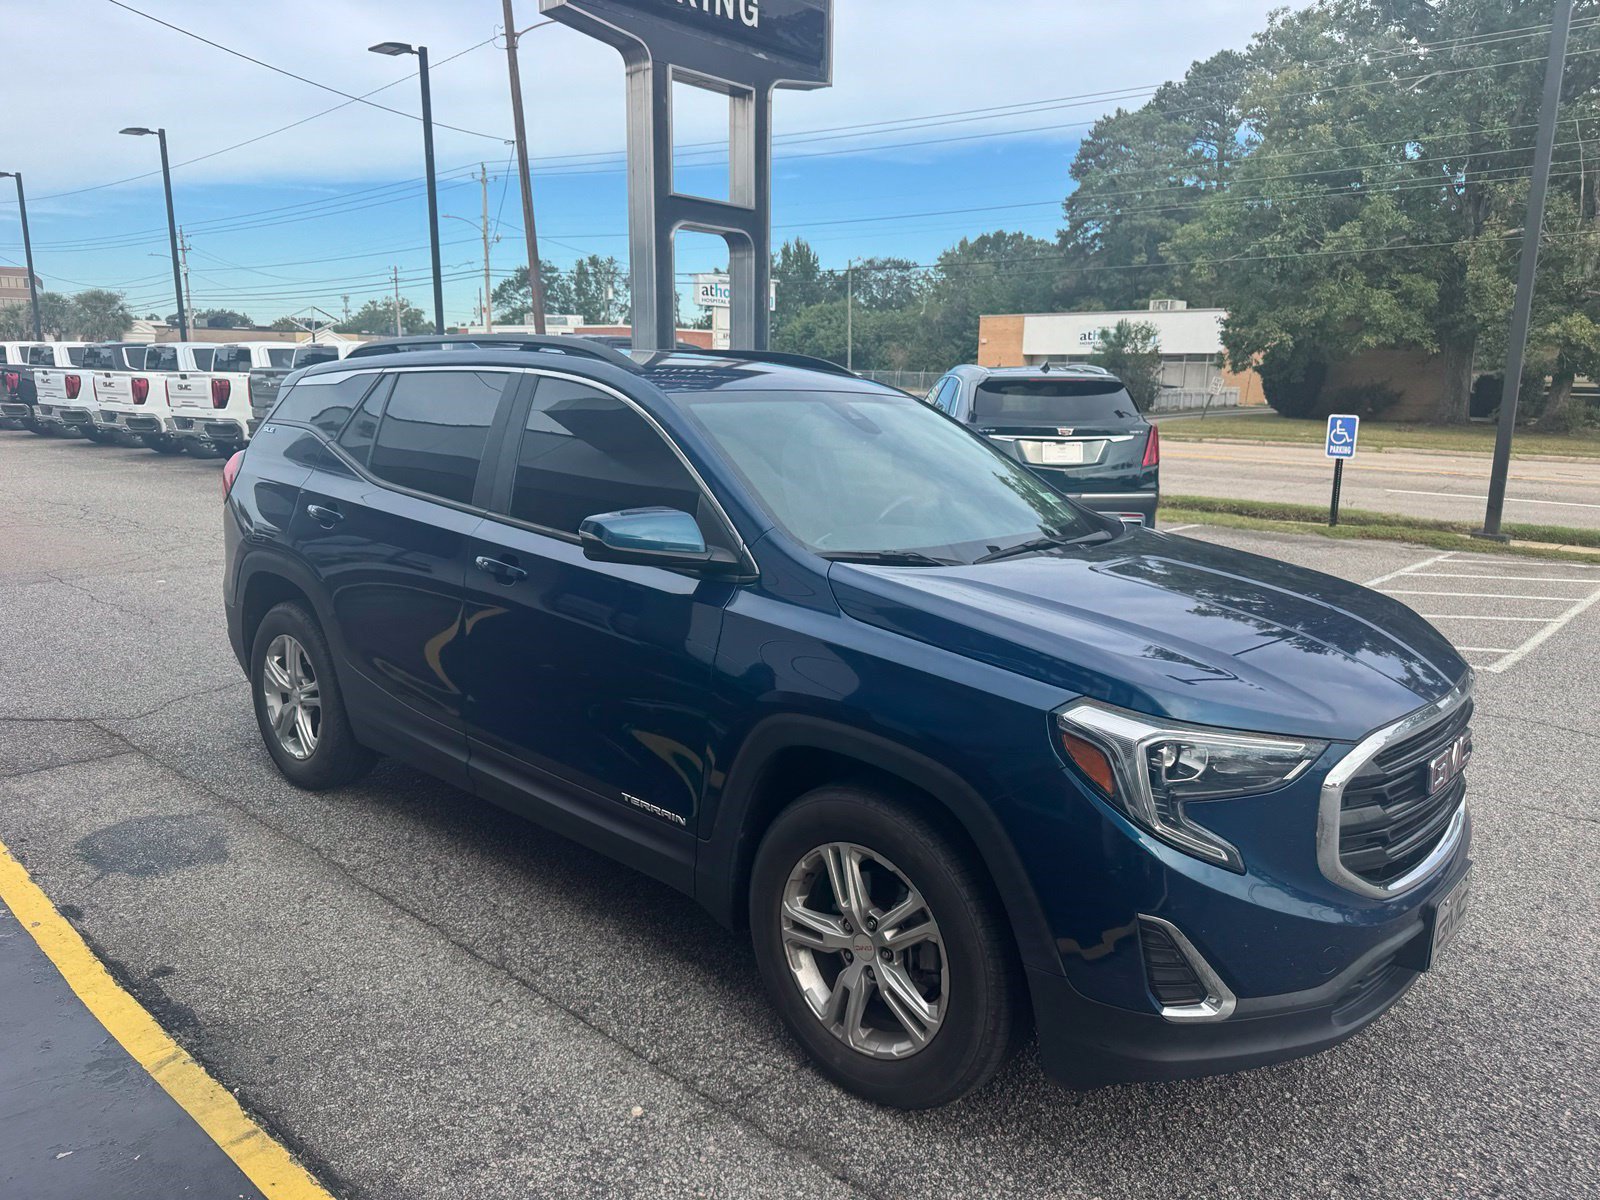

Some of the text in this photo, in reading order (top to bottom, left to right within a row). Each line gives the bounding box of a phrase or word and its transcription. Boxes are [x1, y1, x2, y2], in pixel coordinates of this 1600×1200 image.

[702, 283, 730, 298] atho
[177, 383, 192, 391] GMC
[1329, 445, 1352, 454] PARKING
[1430, 735, 1471, 795] GMC
[621, 792, 686, 827] TERRAIN
